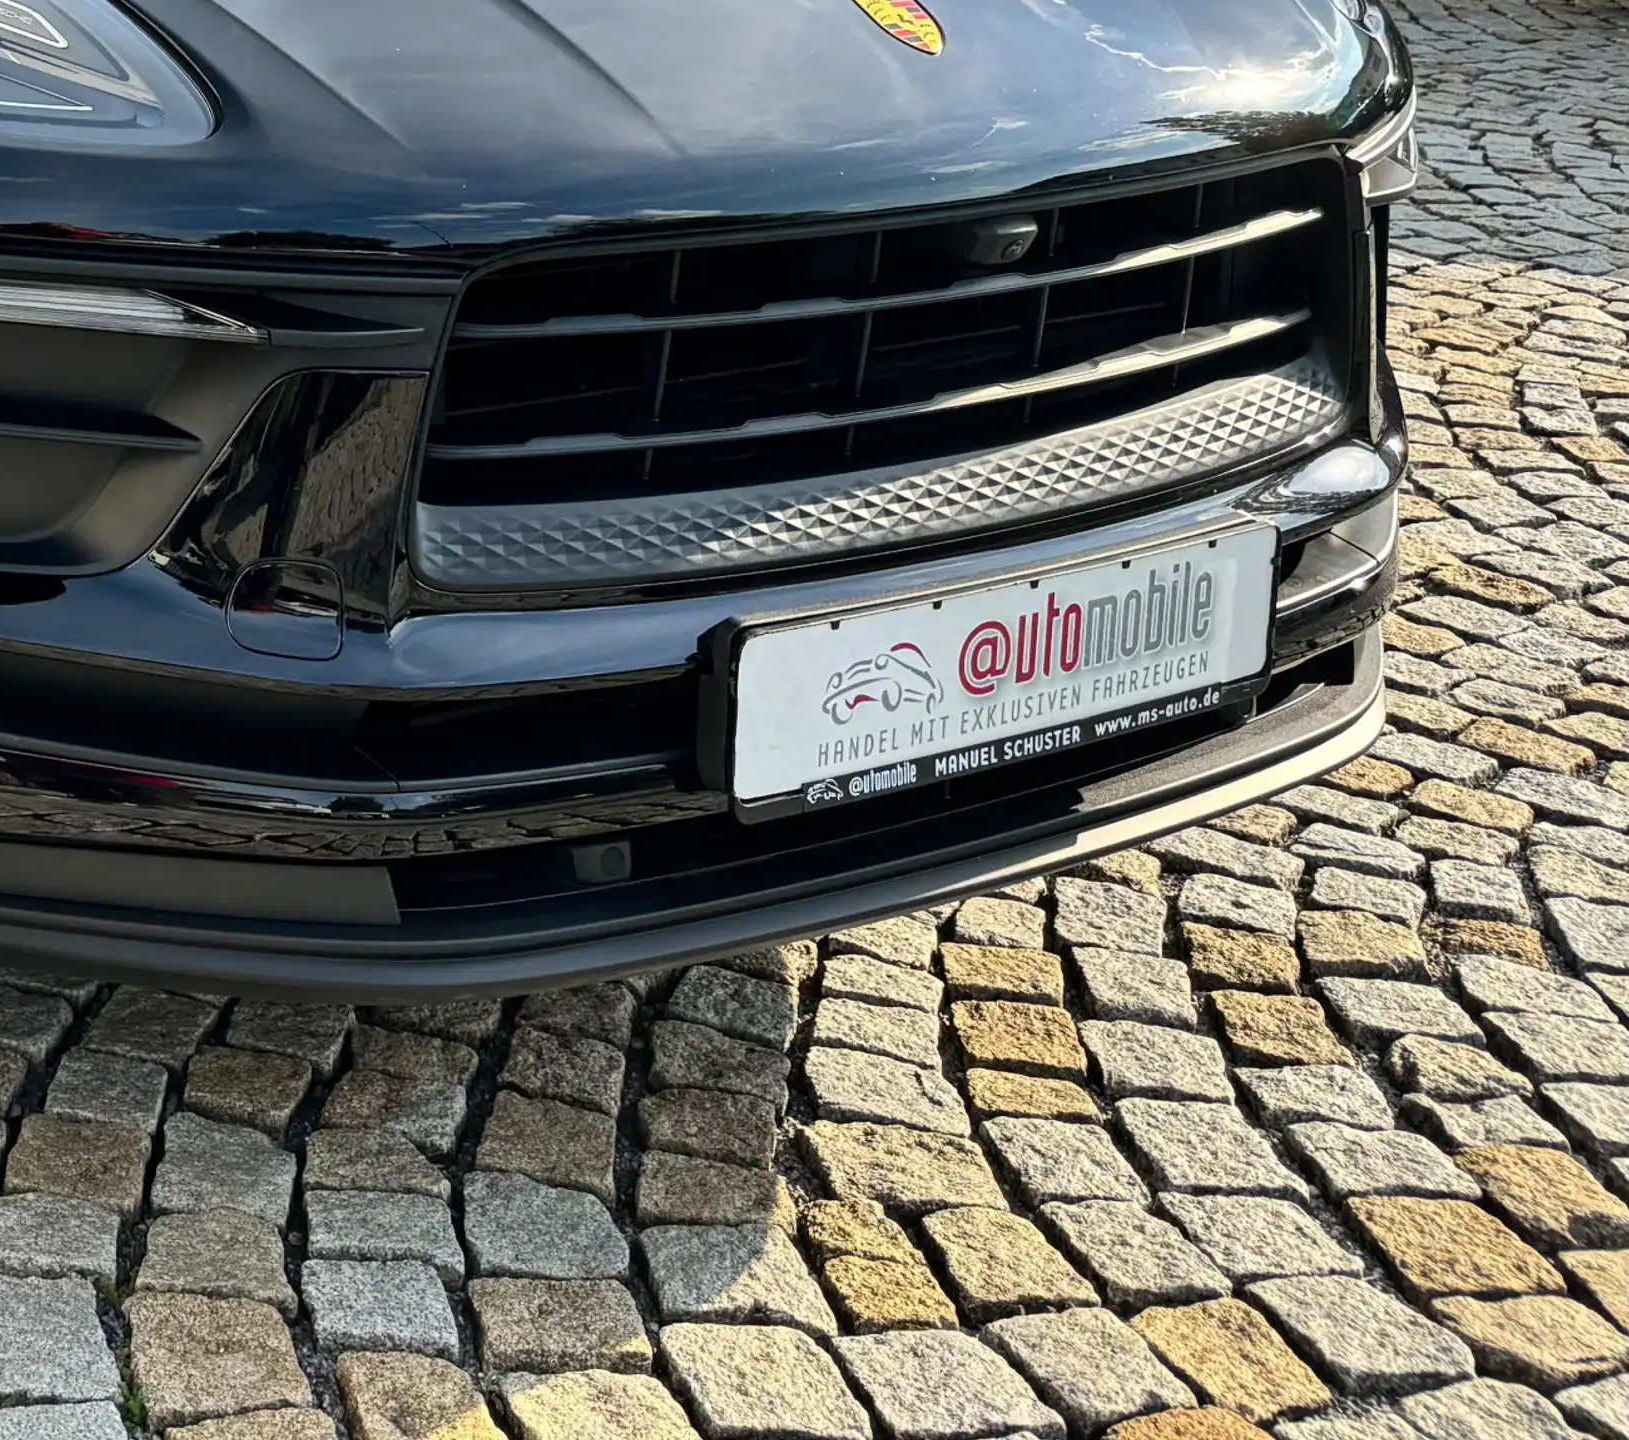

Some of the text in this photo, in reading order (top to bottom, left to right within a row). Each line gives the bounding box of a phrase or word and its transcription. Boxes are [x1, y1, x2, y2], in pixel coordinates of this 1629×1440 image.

[958, 560, 1214, 695] @utomobile
[818, 650, 1210, 768] HANDEL MIT EXKLUSIVEN FAHRZEUGEN
[934, 743, 999, 778] MANUEL
[1003, 725, 1082, 761] SCHUSTER
[1094, 688, 1221, 738] www.ms-auto.de
